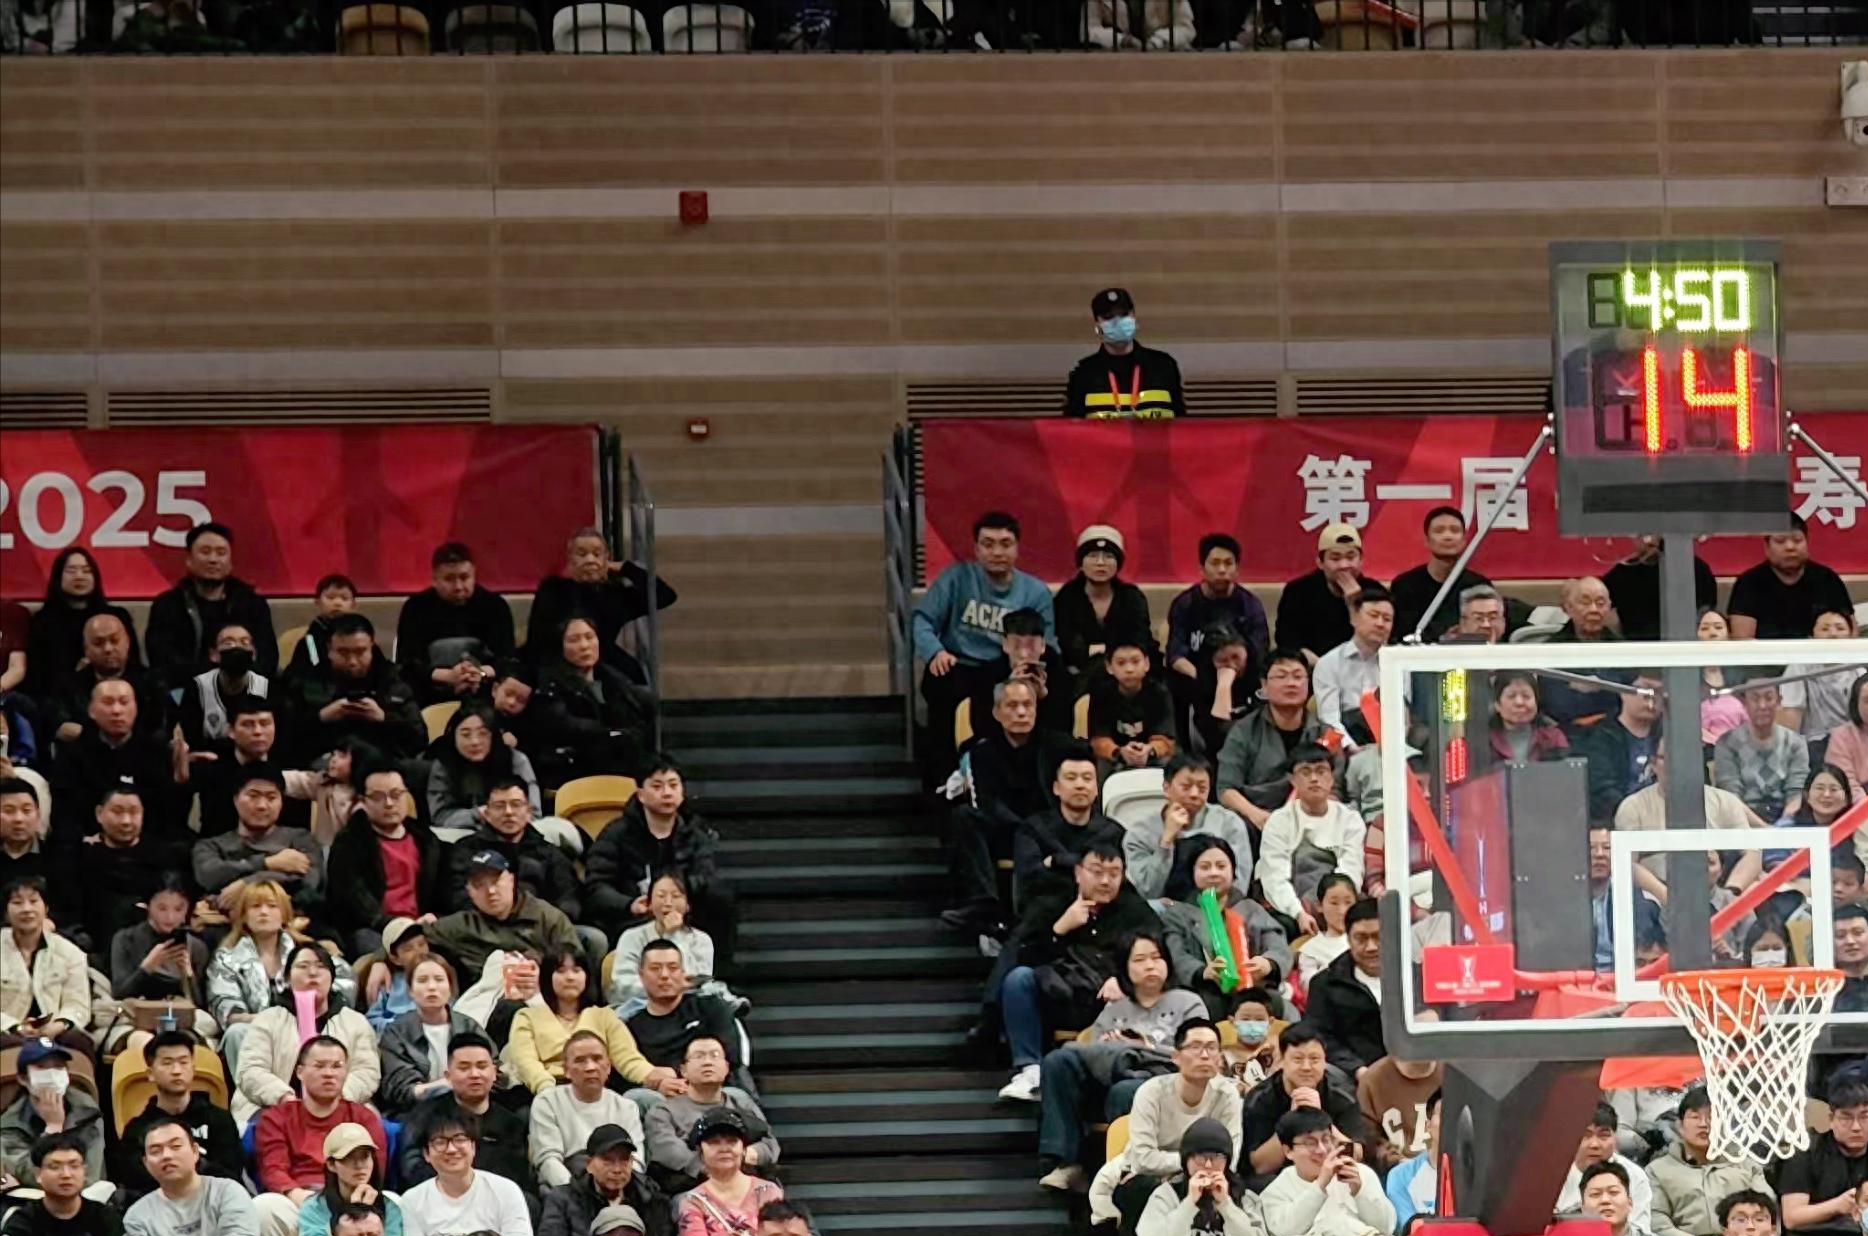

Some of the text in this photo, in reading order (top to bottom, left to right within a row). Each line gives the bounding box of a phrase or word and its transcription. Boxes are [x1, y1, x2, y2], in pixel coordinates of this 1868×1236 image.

[1623, 267, 1751, 333] 4:50
[1643, 346, 1752, 453] 14
[0, 470, 212, 549] 025
[1297, 454, 1529, 532] 第一届
